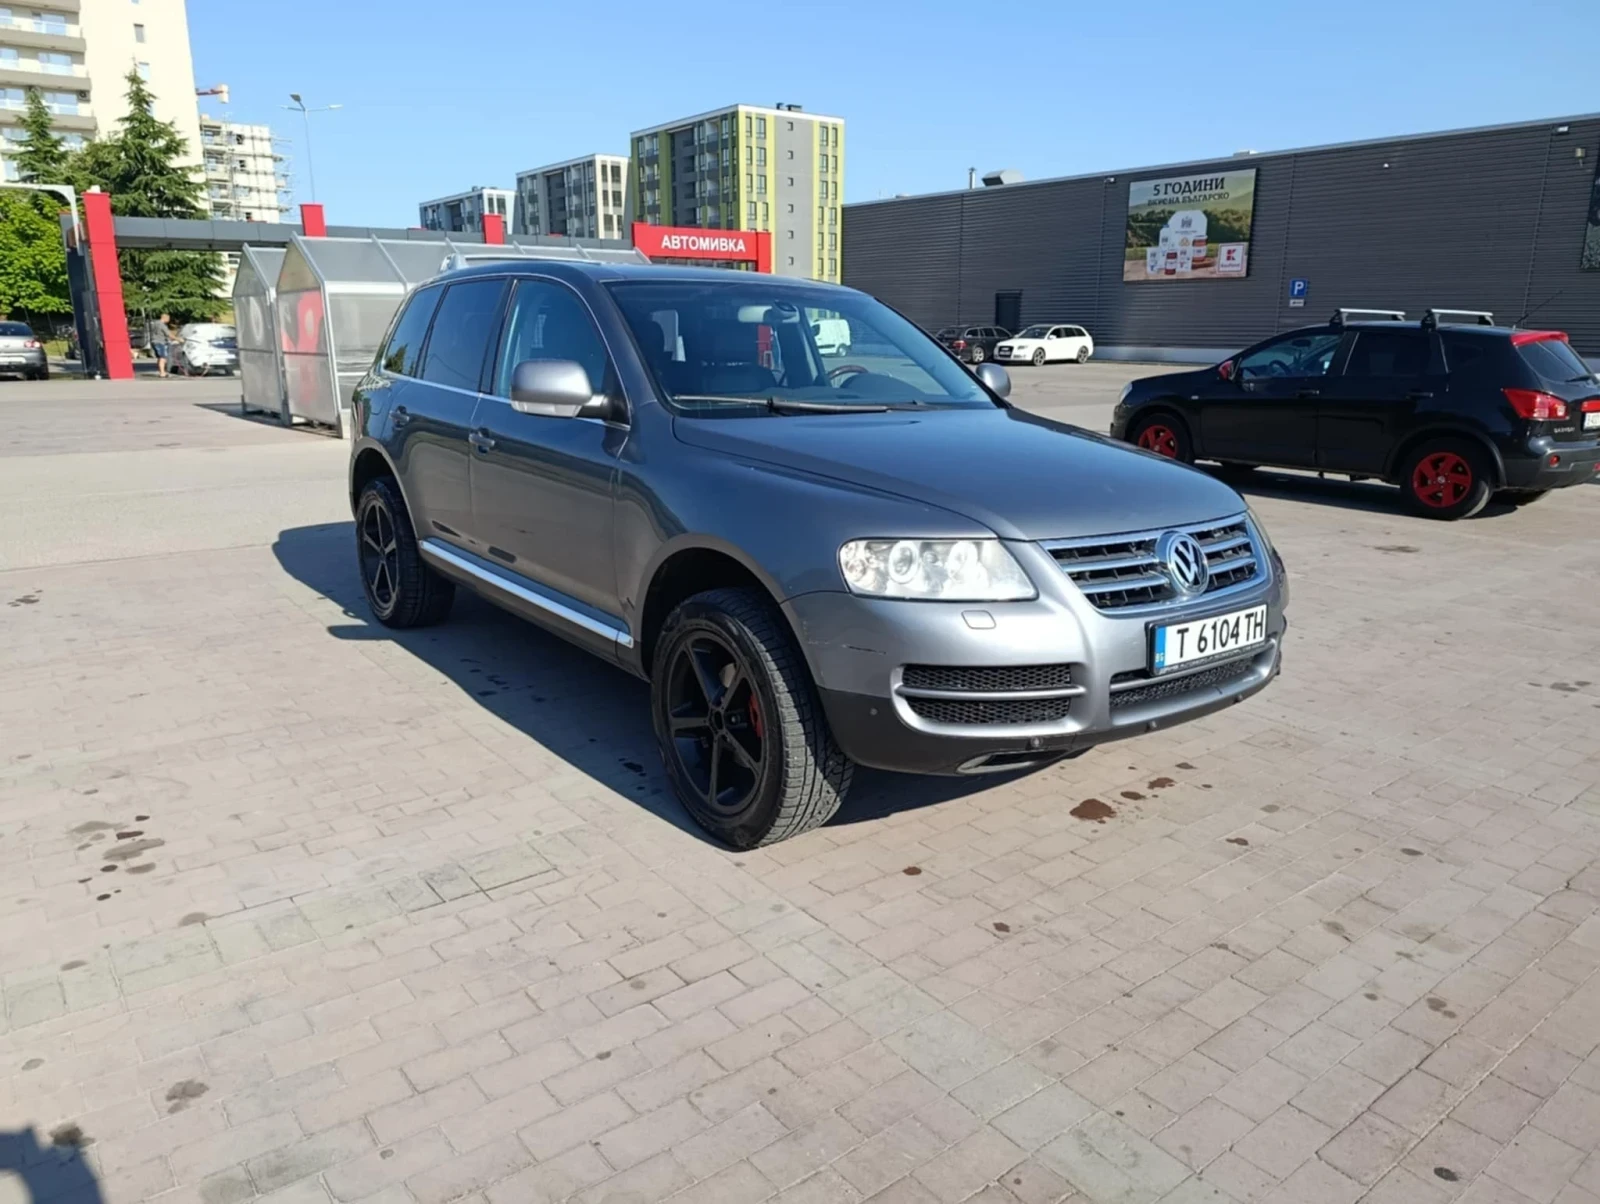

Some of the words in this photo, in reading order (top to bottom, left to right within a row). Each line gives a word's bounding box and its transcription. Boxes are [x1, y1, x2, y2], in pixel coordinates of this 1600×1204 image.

[1153, 184, 1161, 196] 5
[1164, 177, 1225, 195] ГОДИНИ
[661, 234, 746, 252] АВТОМИВКА
[1294, 281, 1304, 295] P
[1177, 627, 1189, 658] T
[1197, 616, 1240, 653] 6104
[1245, 609, 1265, 642] TH
